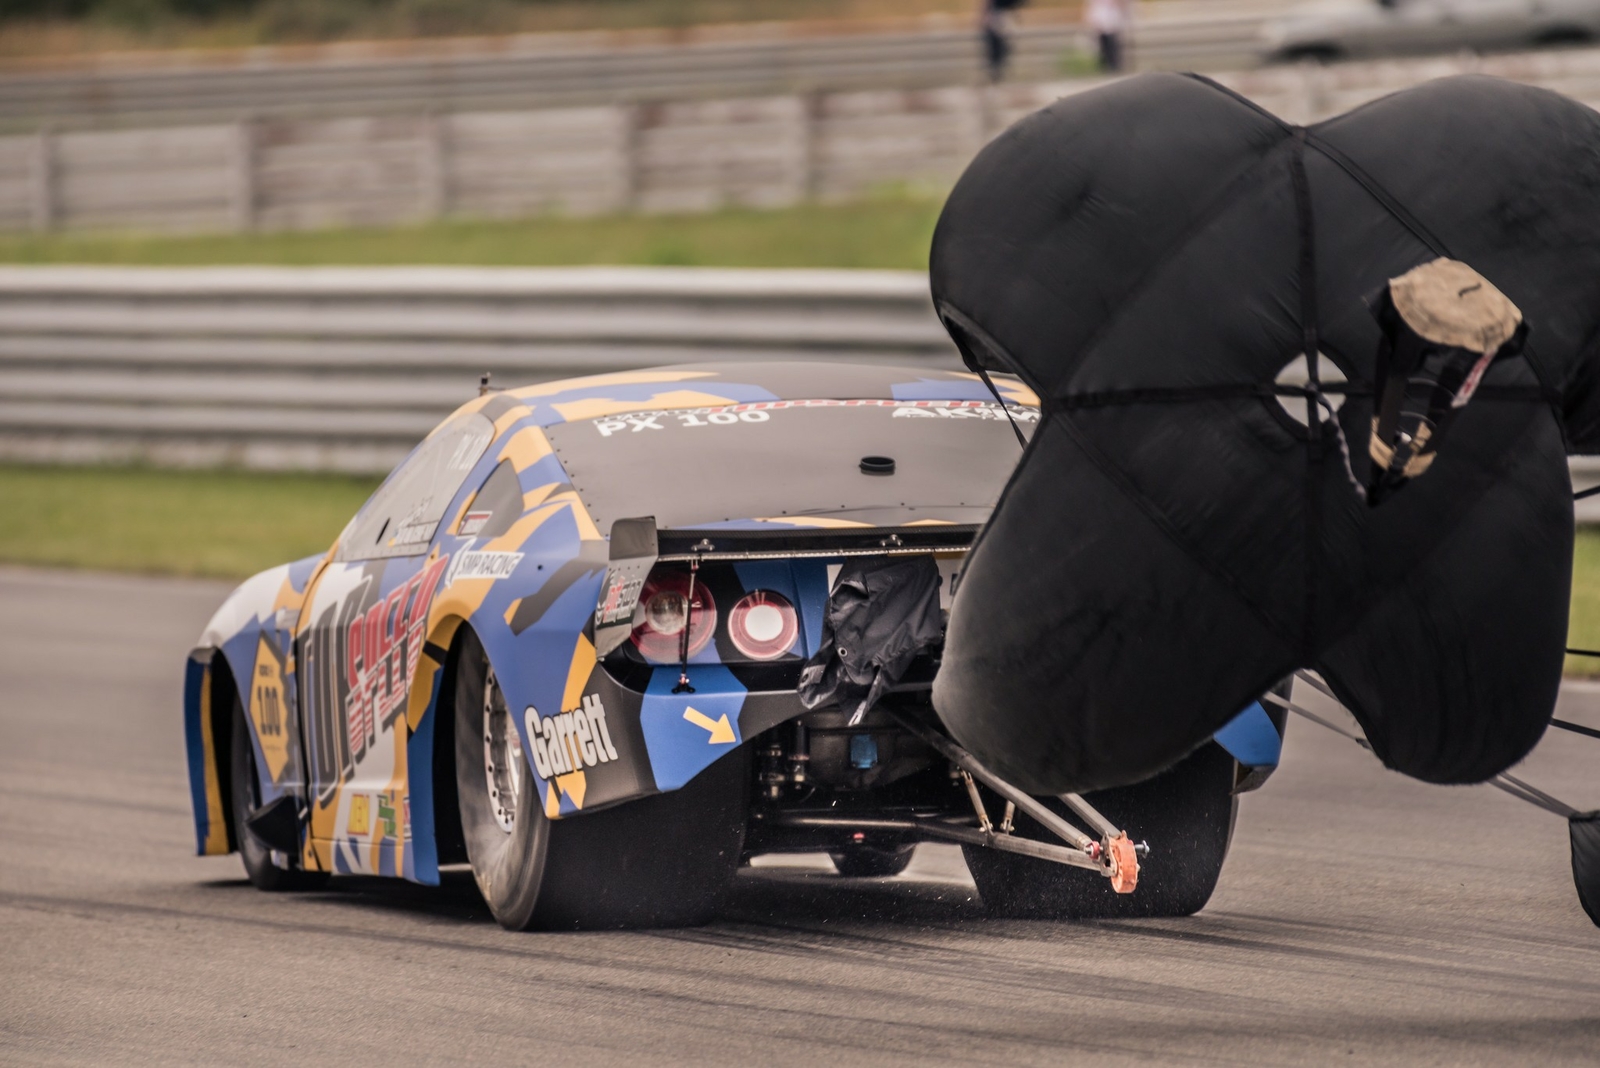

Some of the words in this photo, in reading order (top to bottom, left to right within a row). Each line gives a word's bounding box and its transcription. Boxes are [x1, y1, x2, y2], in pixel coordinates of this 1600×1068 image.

[597, 415, 664, 437] PX
[677, 410, 770, 427] 100
[458, 553, 484, 576] SMP
[477, 553, 519, 576] RACING
[524, 693, 619, 780] Garrett
